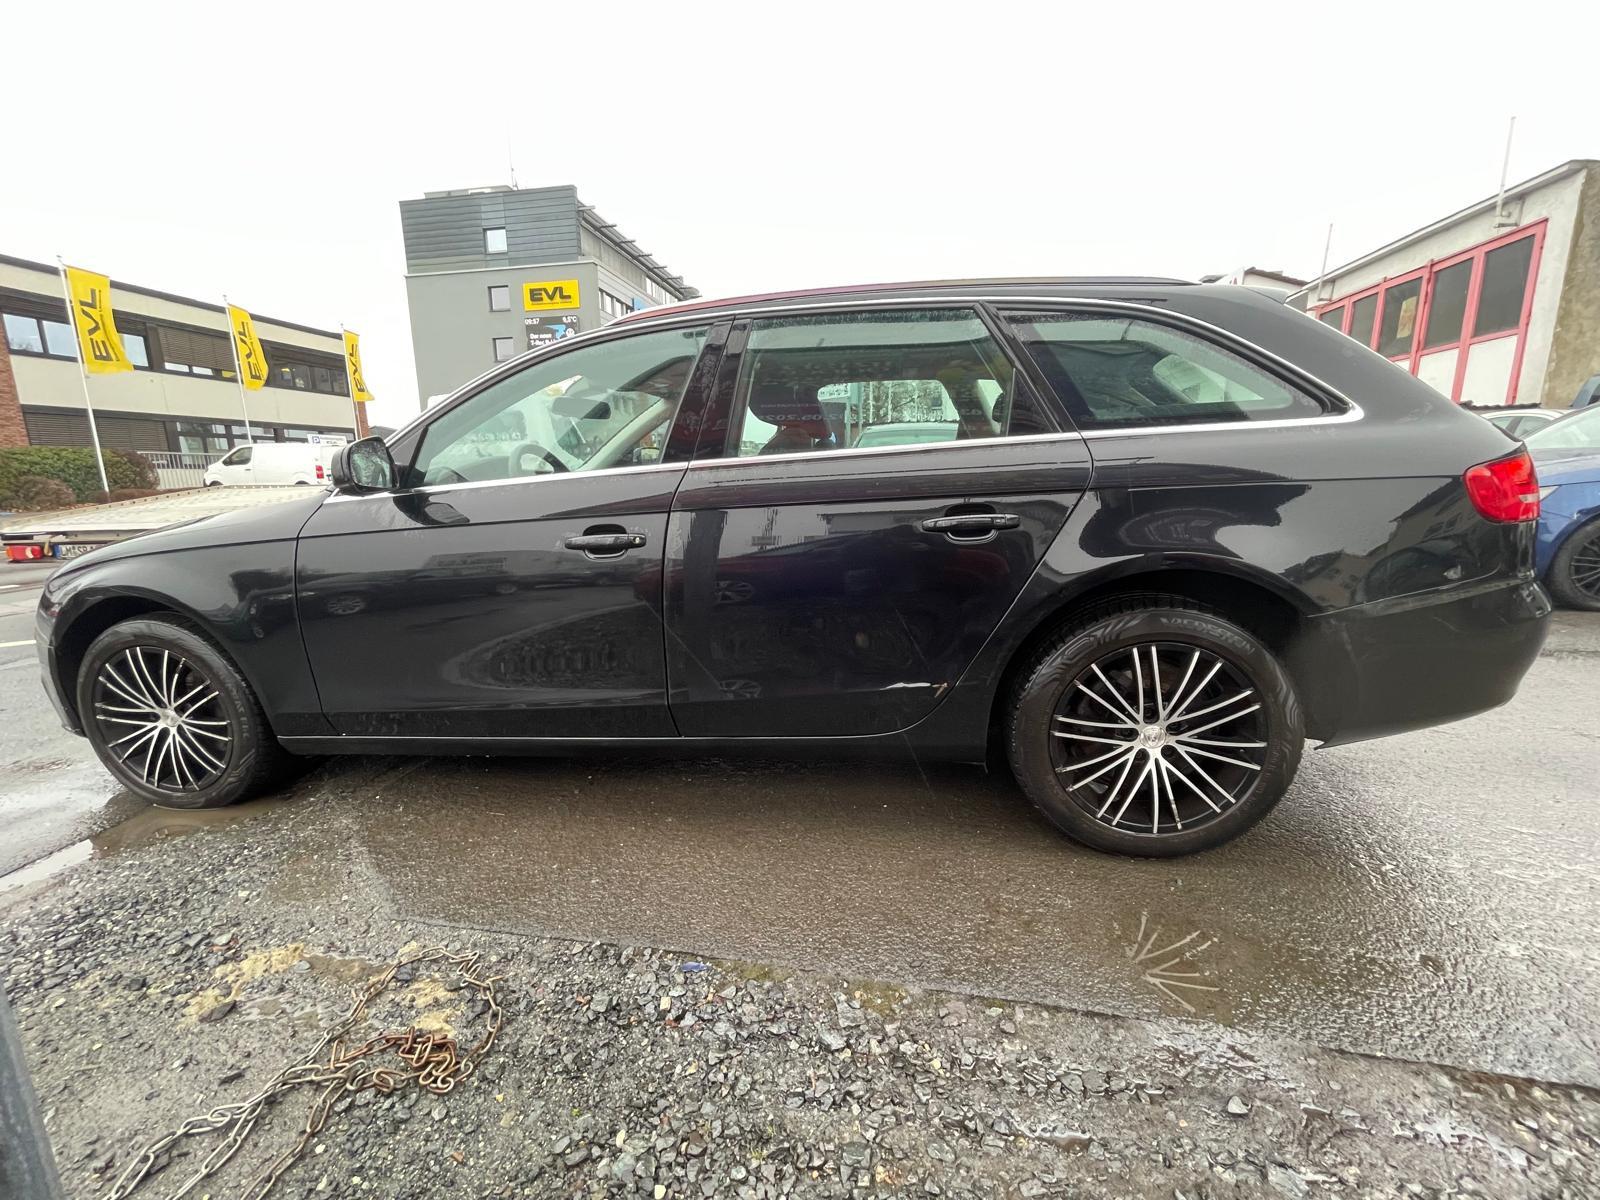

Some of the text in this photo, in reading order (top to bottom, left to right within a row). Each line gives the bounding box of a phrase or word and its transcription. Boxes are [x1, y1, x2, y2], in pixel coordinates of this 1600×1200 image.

[529, 286, 572, 302] EVL
[79, 288, 113, 362] EVL
[238, 321, 262, 381] EVL
[349, 344, 365, 393] EVL
